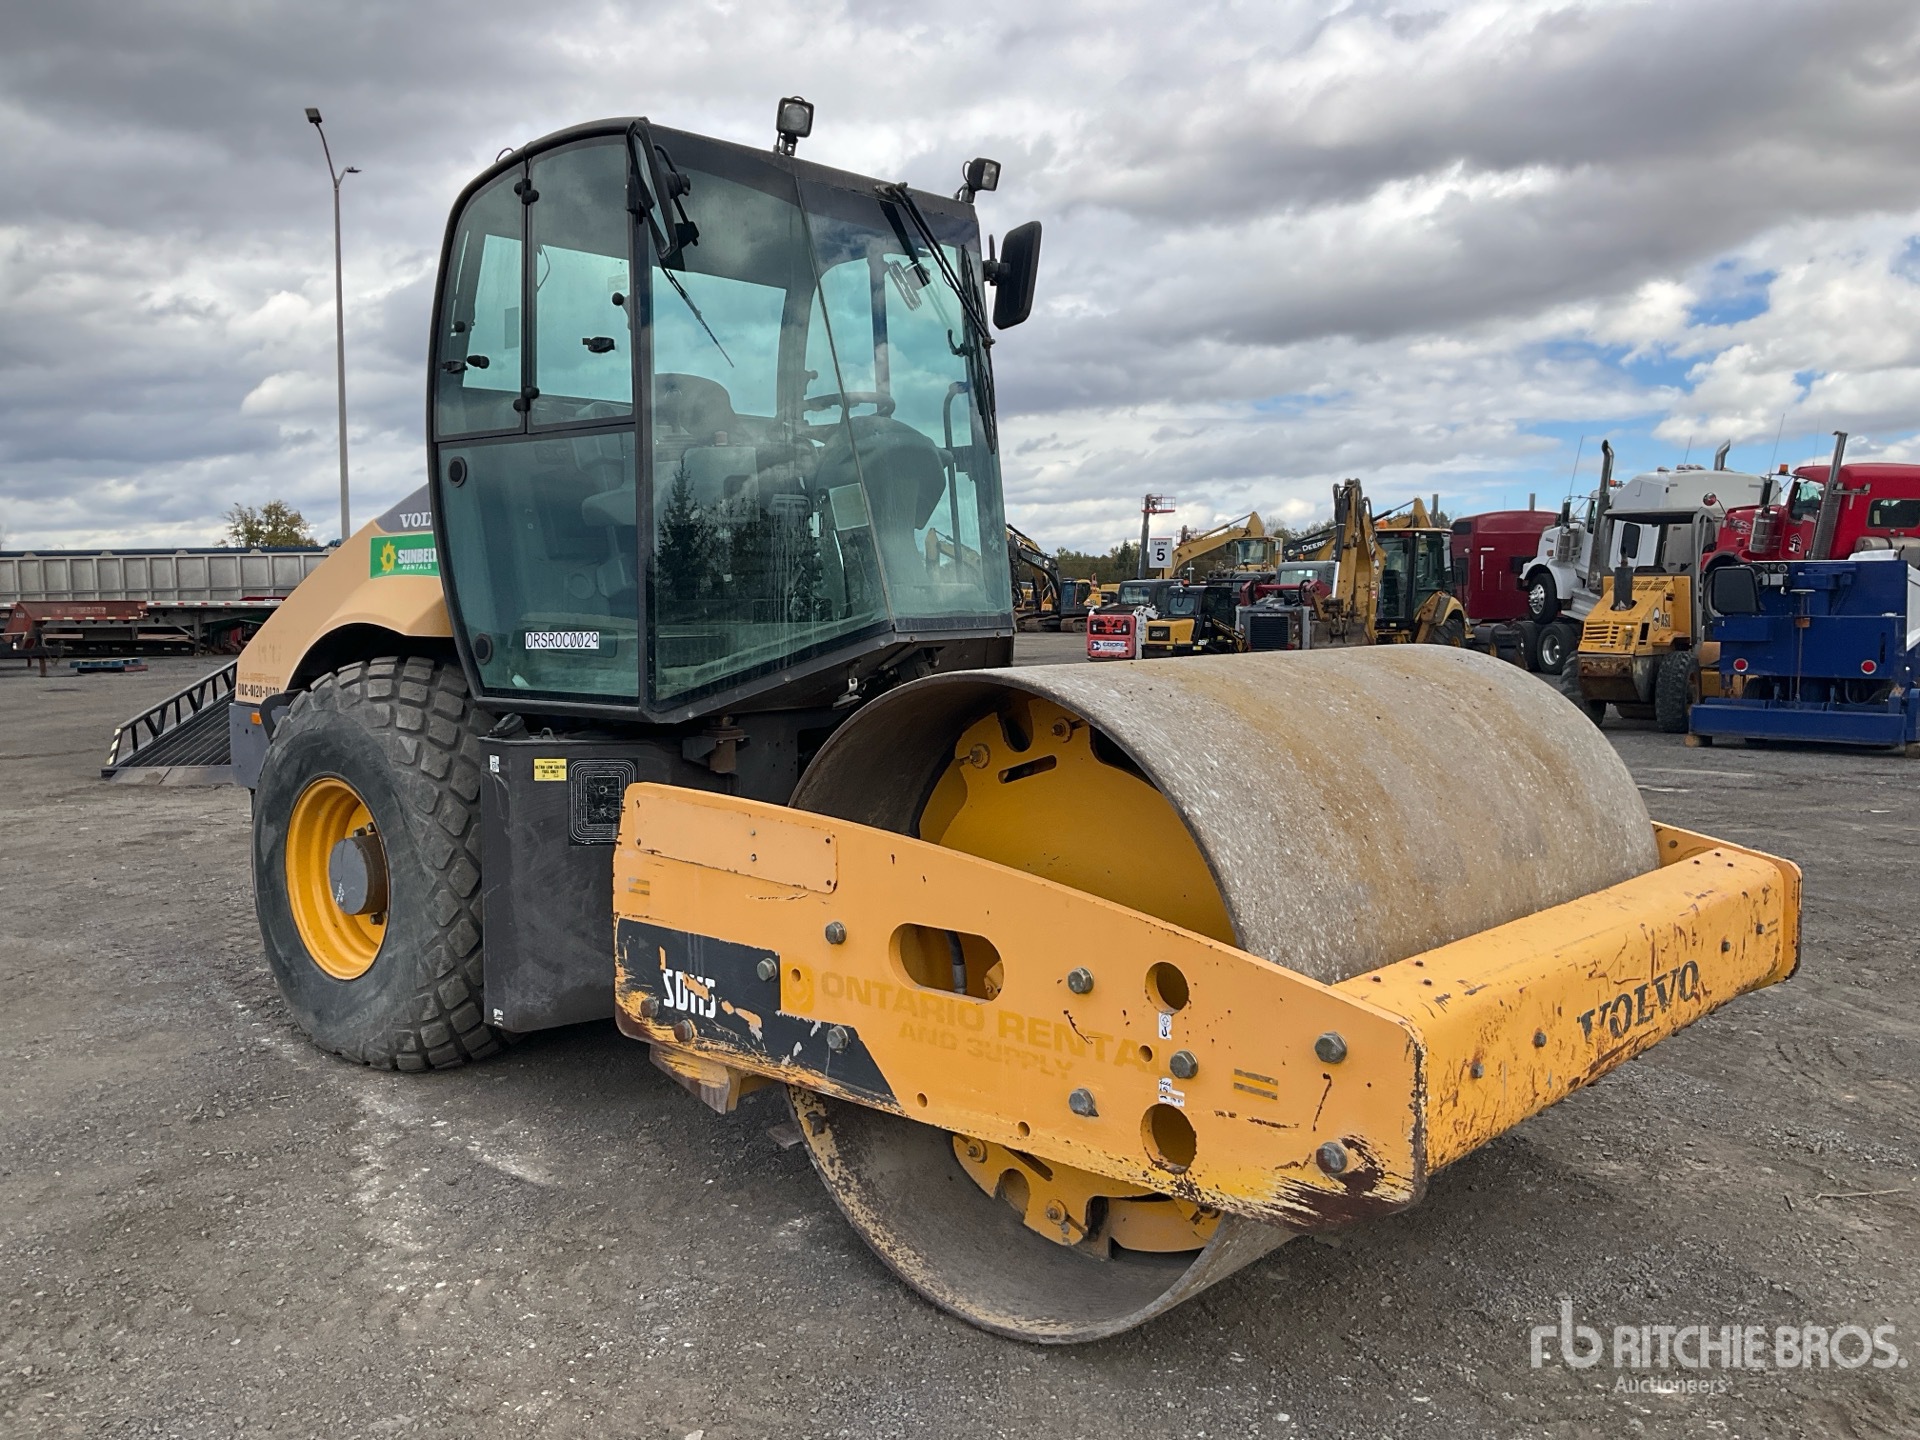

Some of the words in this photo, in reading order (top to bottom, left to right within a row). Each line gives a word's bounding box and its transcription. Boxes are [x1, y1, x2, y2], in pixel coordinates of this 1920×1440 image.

[400, 512, 432, 528] VOL
[397, 548, 438, 564] SUNBELT
[1156, 548, 1166, 561] 5
[1577, 961, 1700, 1041] VOLVO
[822, 971, 986, 1032] ONTARIO
[998, 1009, 1172, 1076] RENTAL
[900, 1022, 958, 1051] AND
[966, 1035, 1075, 1079] SUPPLY
